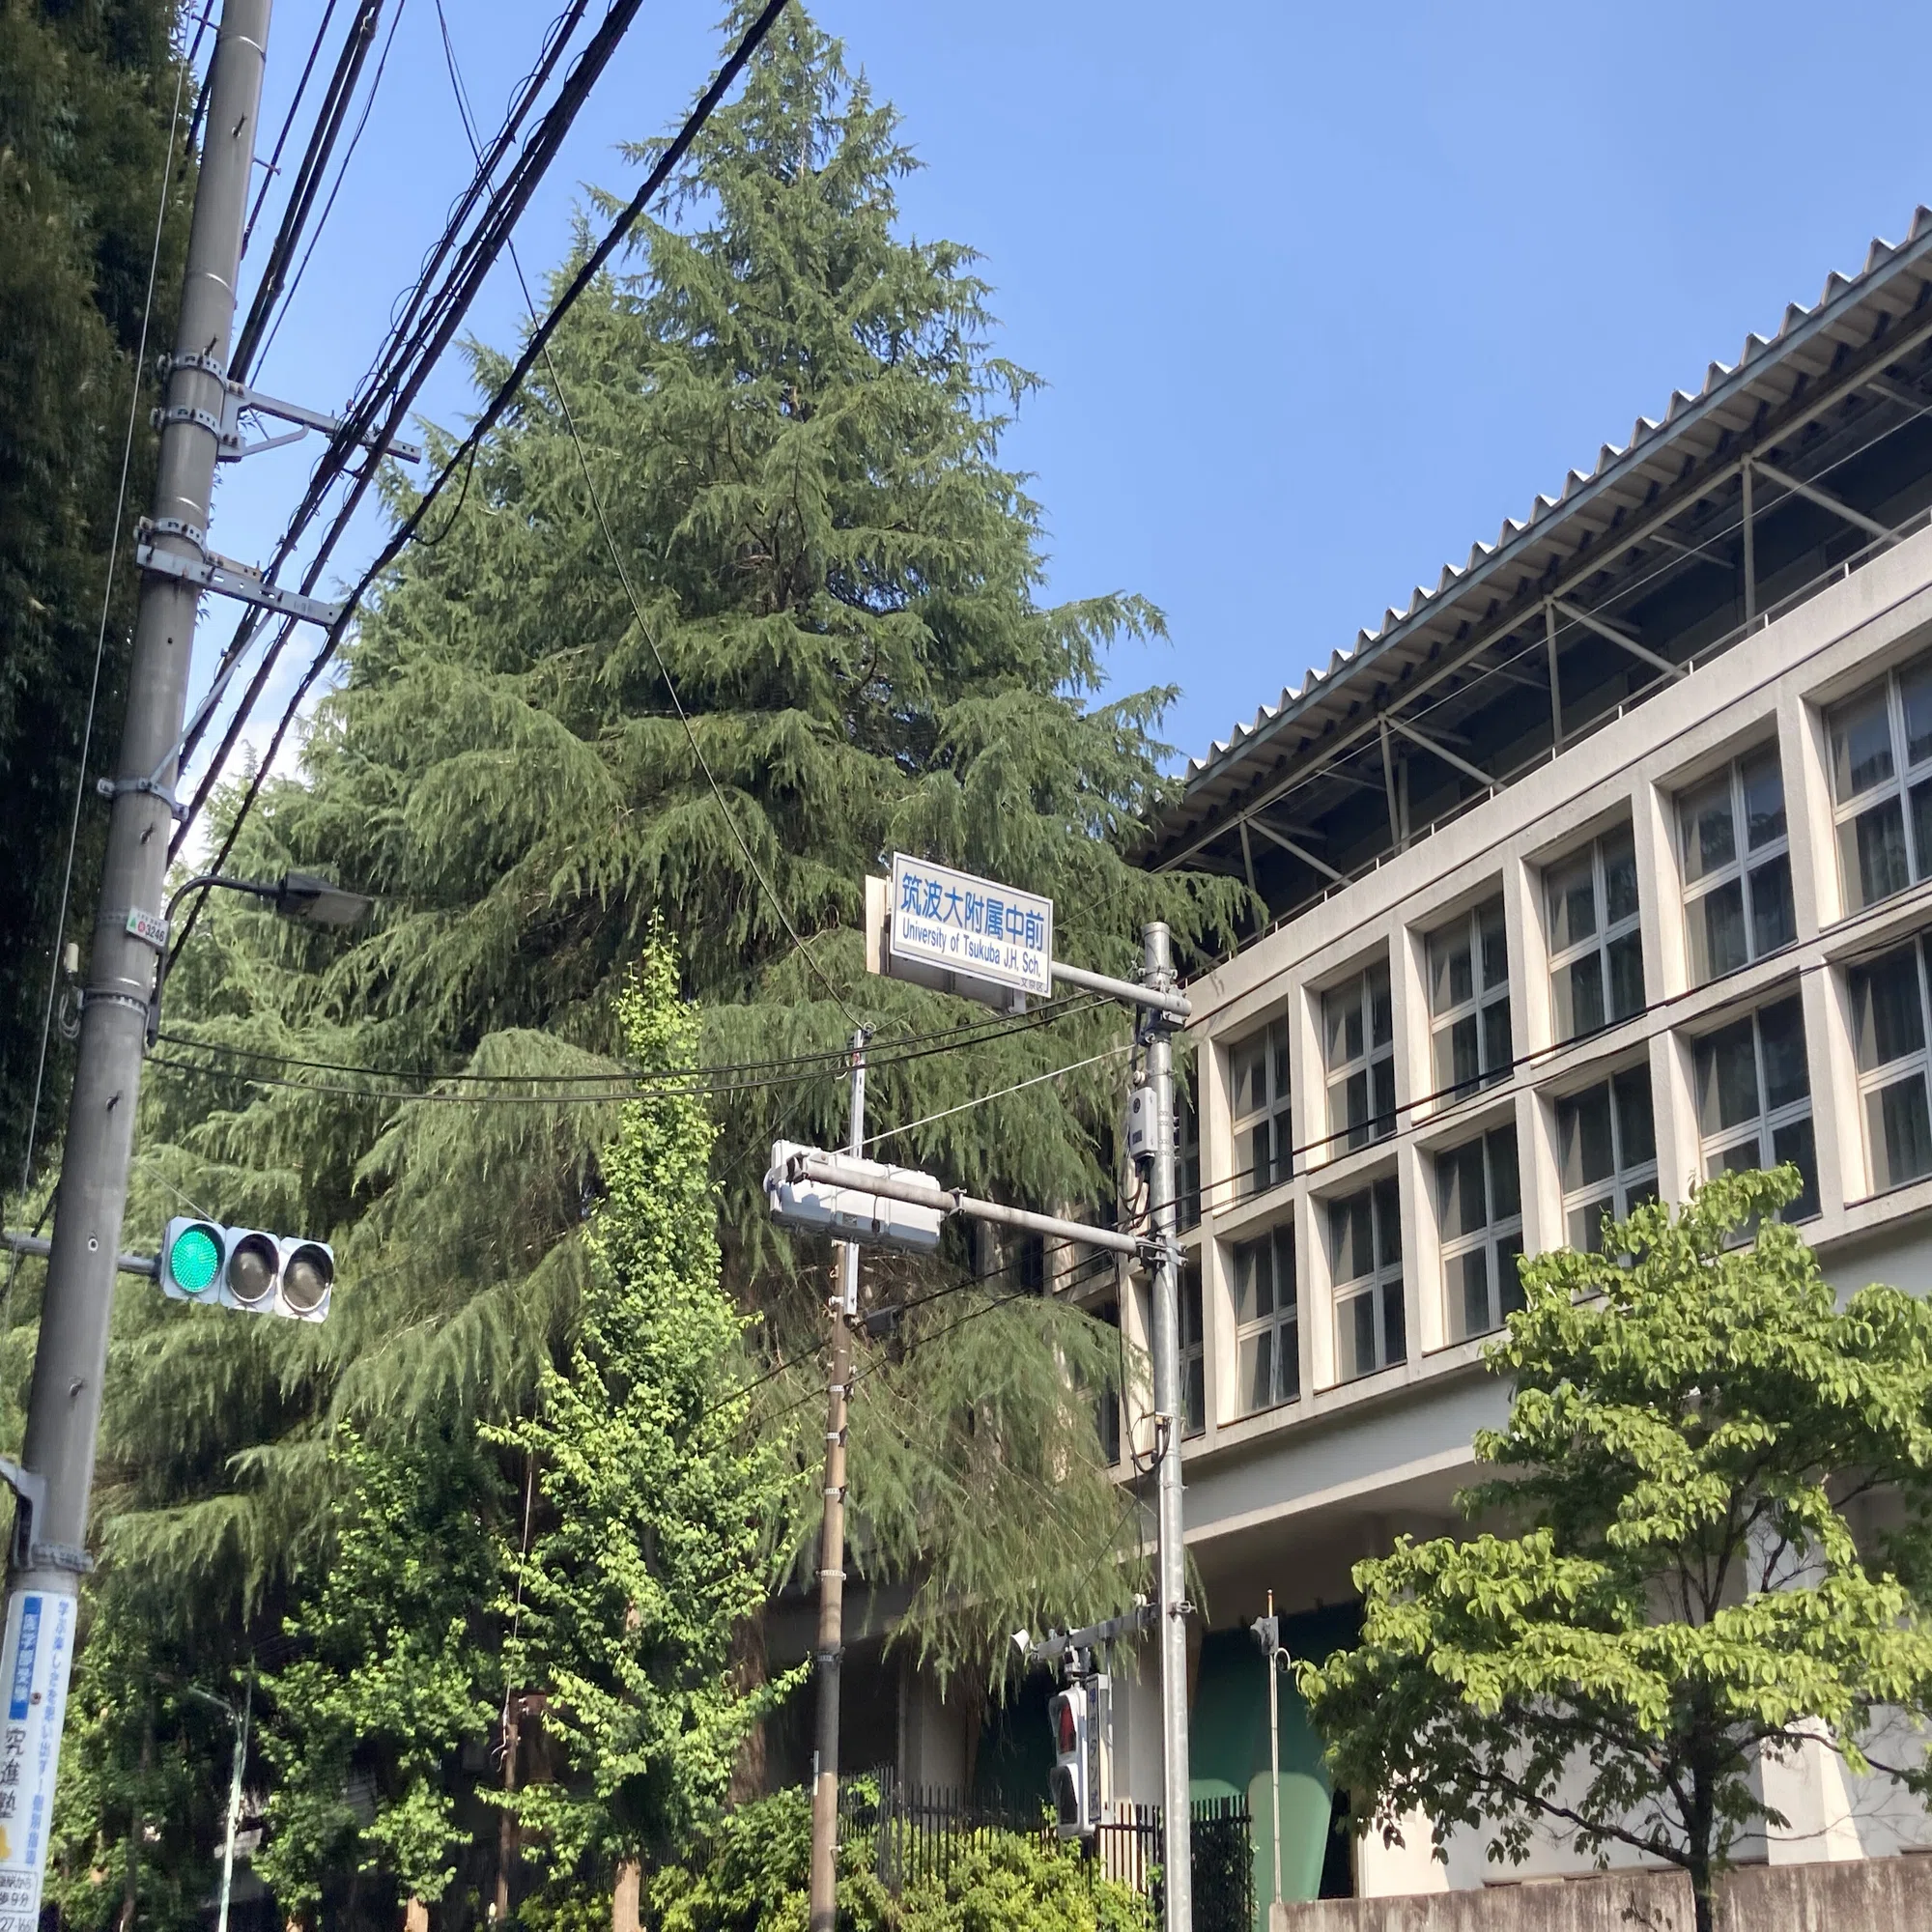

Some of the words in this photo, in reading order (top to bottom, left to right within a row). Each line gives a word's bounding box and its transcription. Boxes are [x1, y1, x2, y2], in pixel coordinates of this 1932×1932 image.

[900, 873, 1044, 951] 筑波大附属中前
[146, 924, 165, 942] 3246
[902, 918, 947, 953] University
[951, 934, 959, 952] of
[963, 934, 1000, 964] Tsukuba
[1004, 948, 1019, 971] J.H.
[1022, 952, 1041, 978] Sch.
[1020, 978, 1044, 992] 文京区
